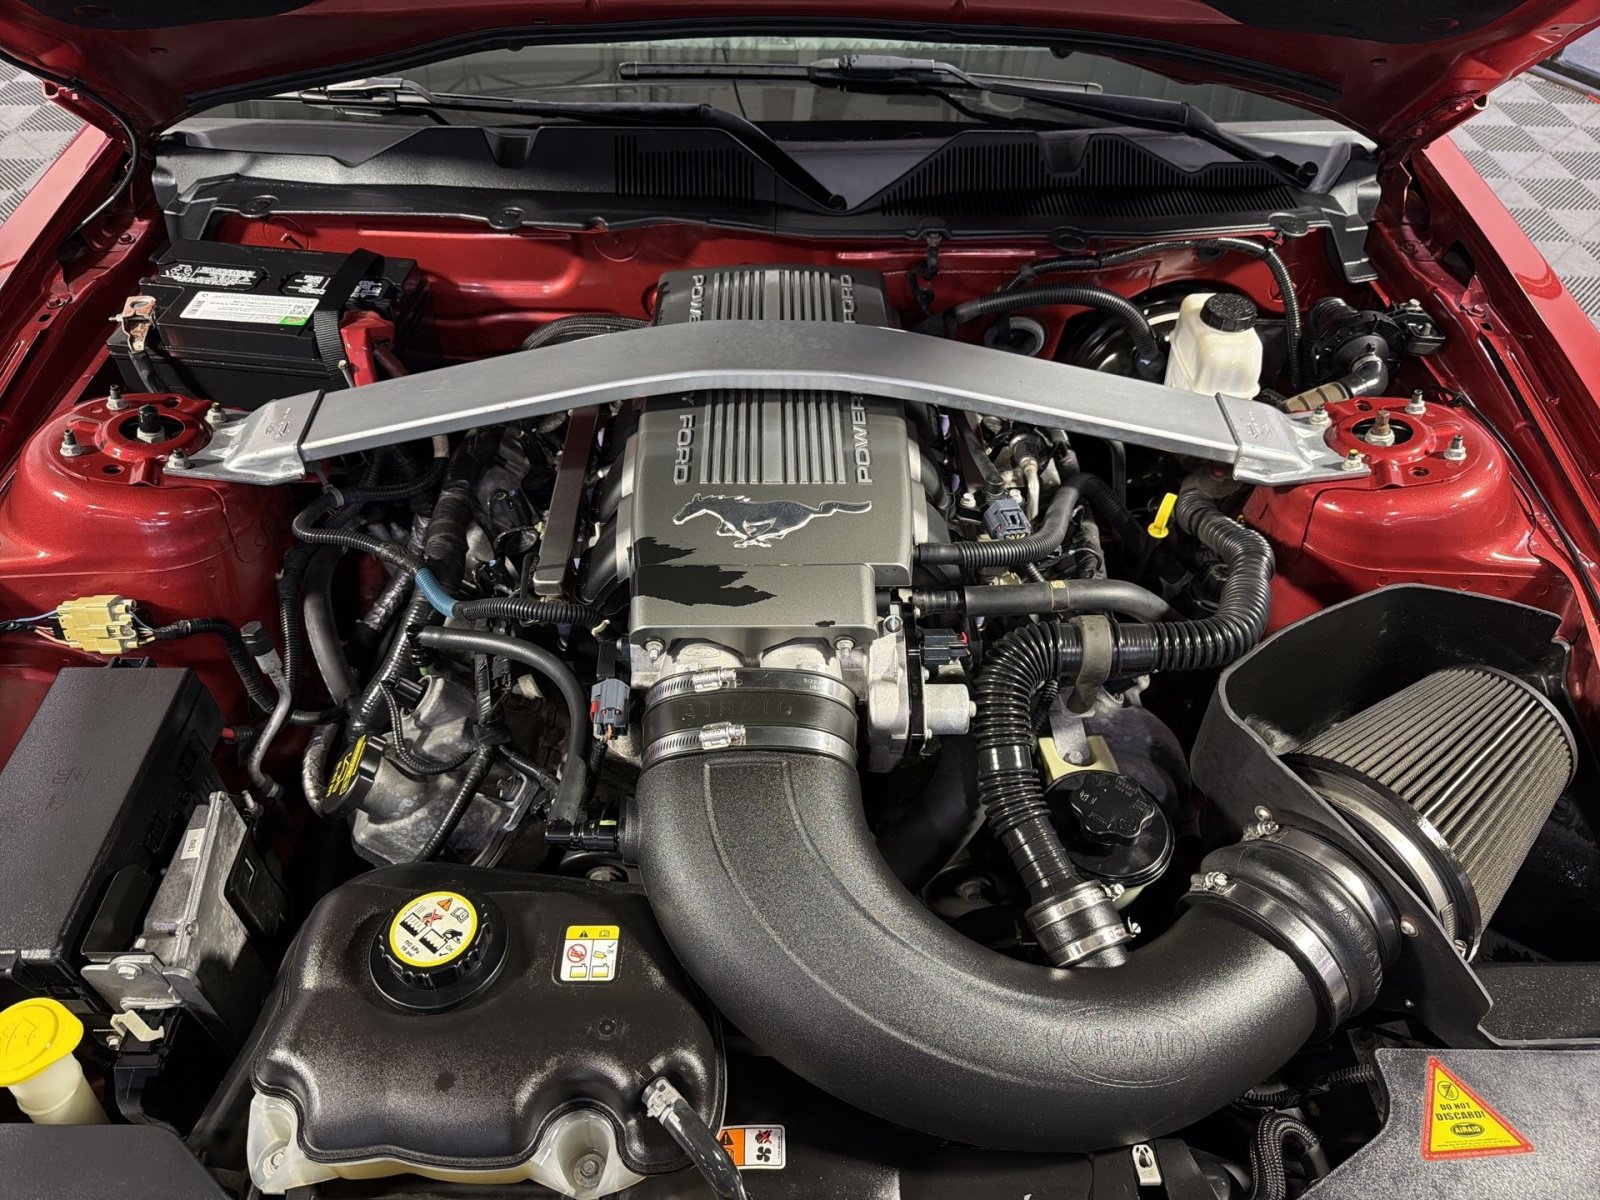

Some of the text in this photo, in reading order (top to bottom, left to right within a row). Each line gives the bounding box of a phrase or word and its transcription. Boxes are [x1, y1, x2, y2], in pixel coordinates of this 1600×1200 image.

[689, 275, 705, 322] POWE
[840, 275, 856, 323] FORD
[673, 414, 694, 485] FORD
[851, 394, 873, 485] POWER
[1435, 1110, 1487, 1121] DISCARD!
[1440, 1102, 1471, 1111] DO NOT
[1454, 1124, 1481, 1134] AIRAID
